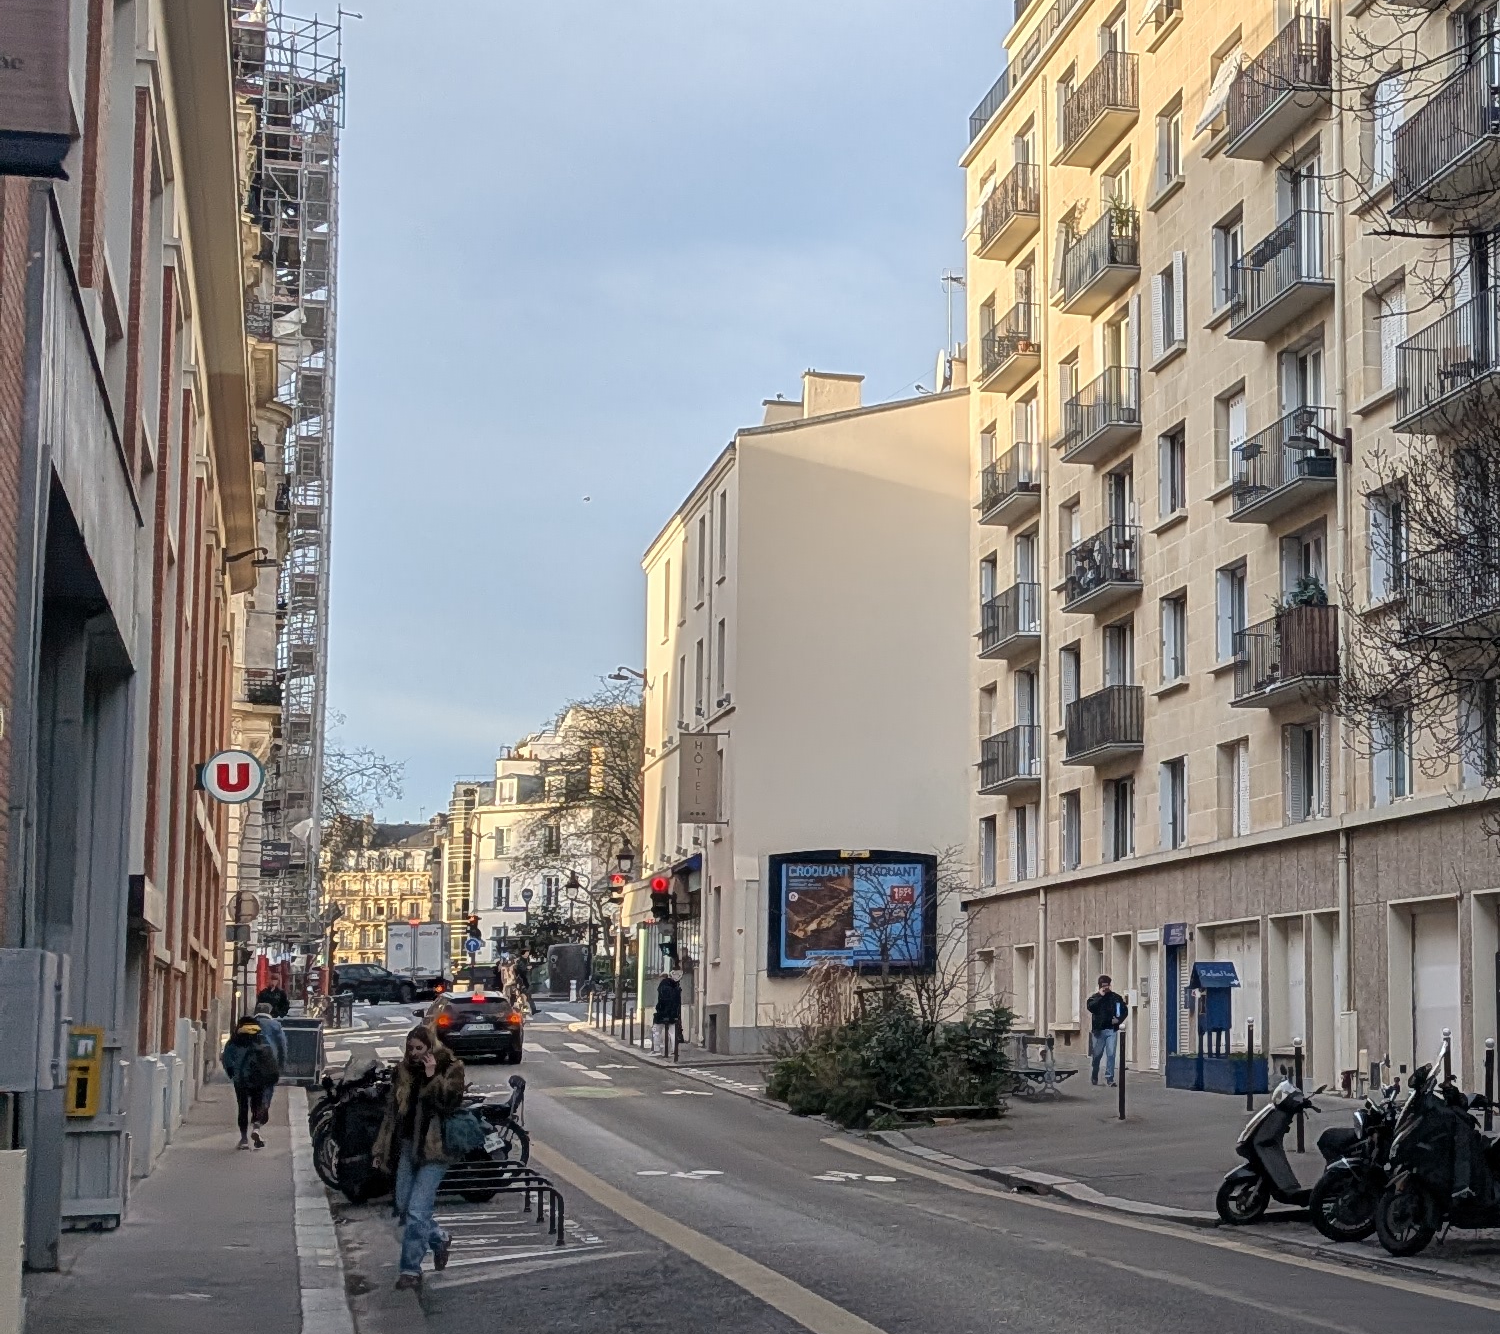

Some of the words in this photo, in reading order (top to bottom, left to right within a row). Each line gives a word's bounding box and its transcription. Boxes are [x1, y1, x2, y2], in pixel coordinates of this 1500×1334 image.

[216, 763, 250, 792] U
[694, 740, 704, 804] HÔTEL
[788, 866, 849, 877] CROQUANT
